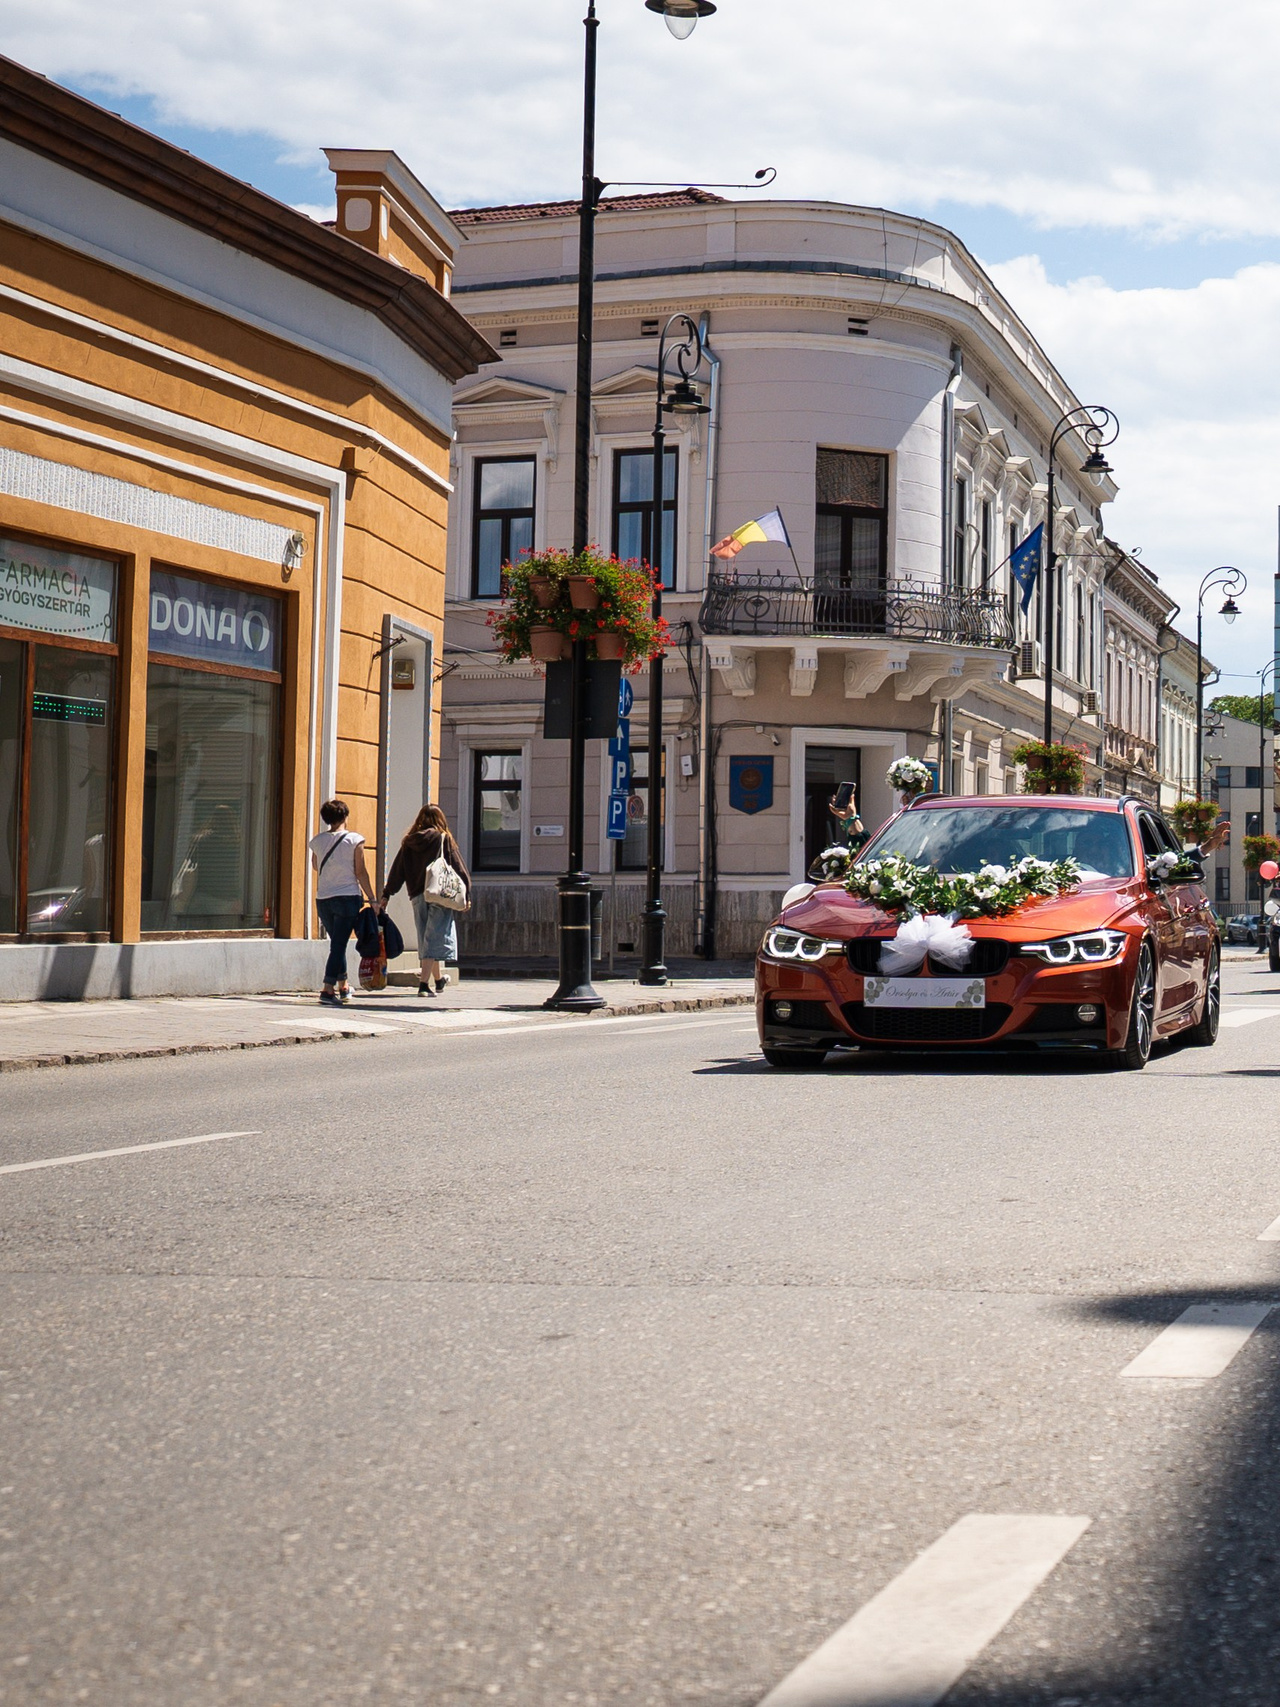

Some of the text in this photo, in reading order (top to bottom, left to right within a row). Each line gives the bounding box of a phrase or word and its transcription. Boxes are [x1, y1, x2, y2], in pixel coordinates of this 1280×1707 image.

[151, 591, 237, 645] DONA
[616, 760, 627, 789] P
[612, 800, 623, 825] P
